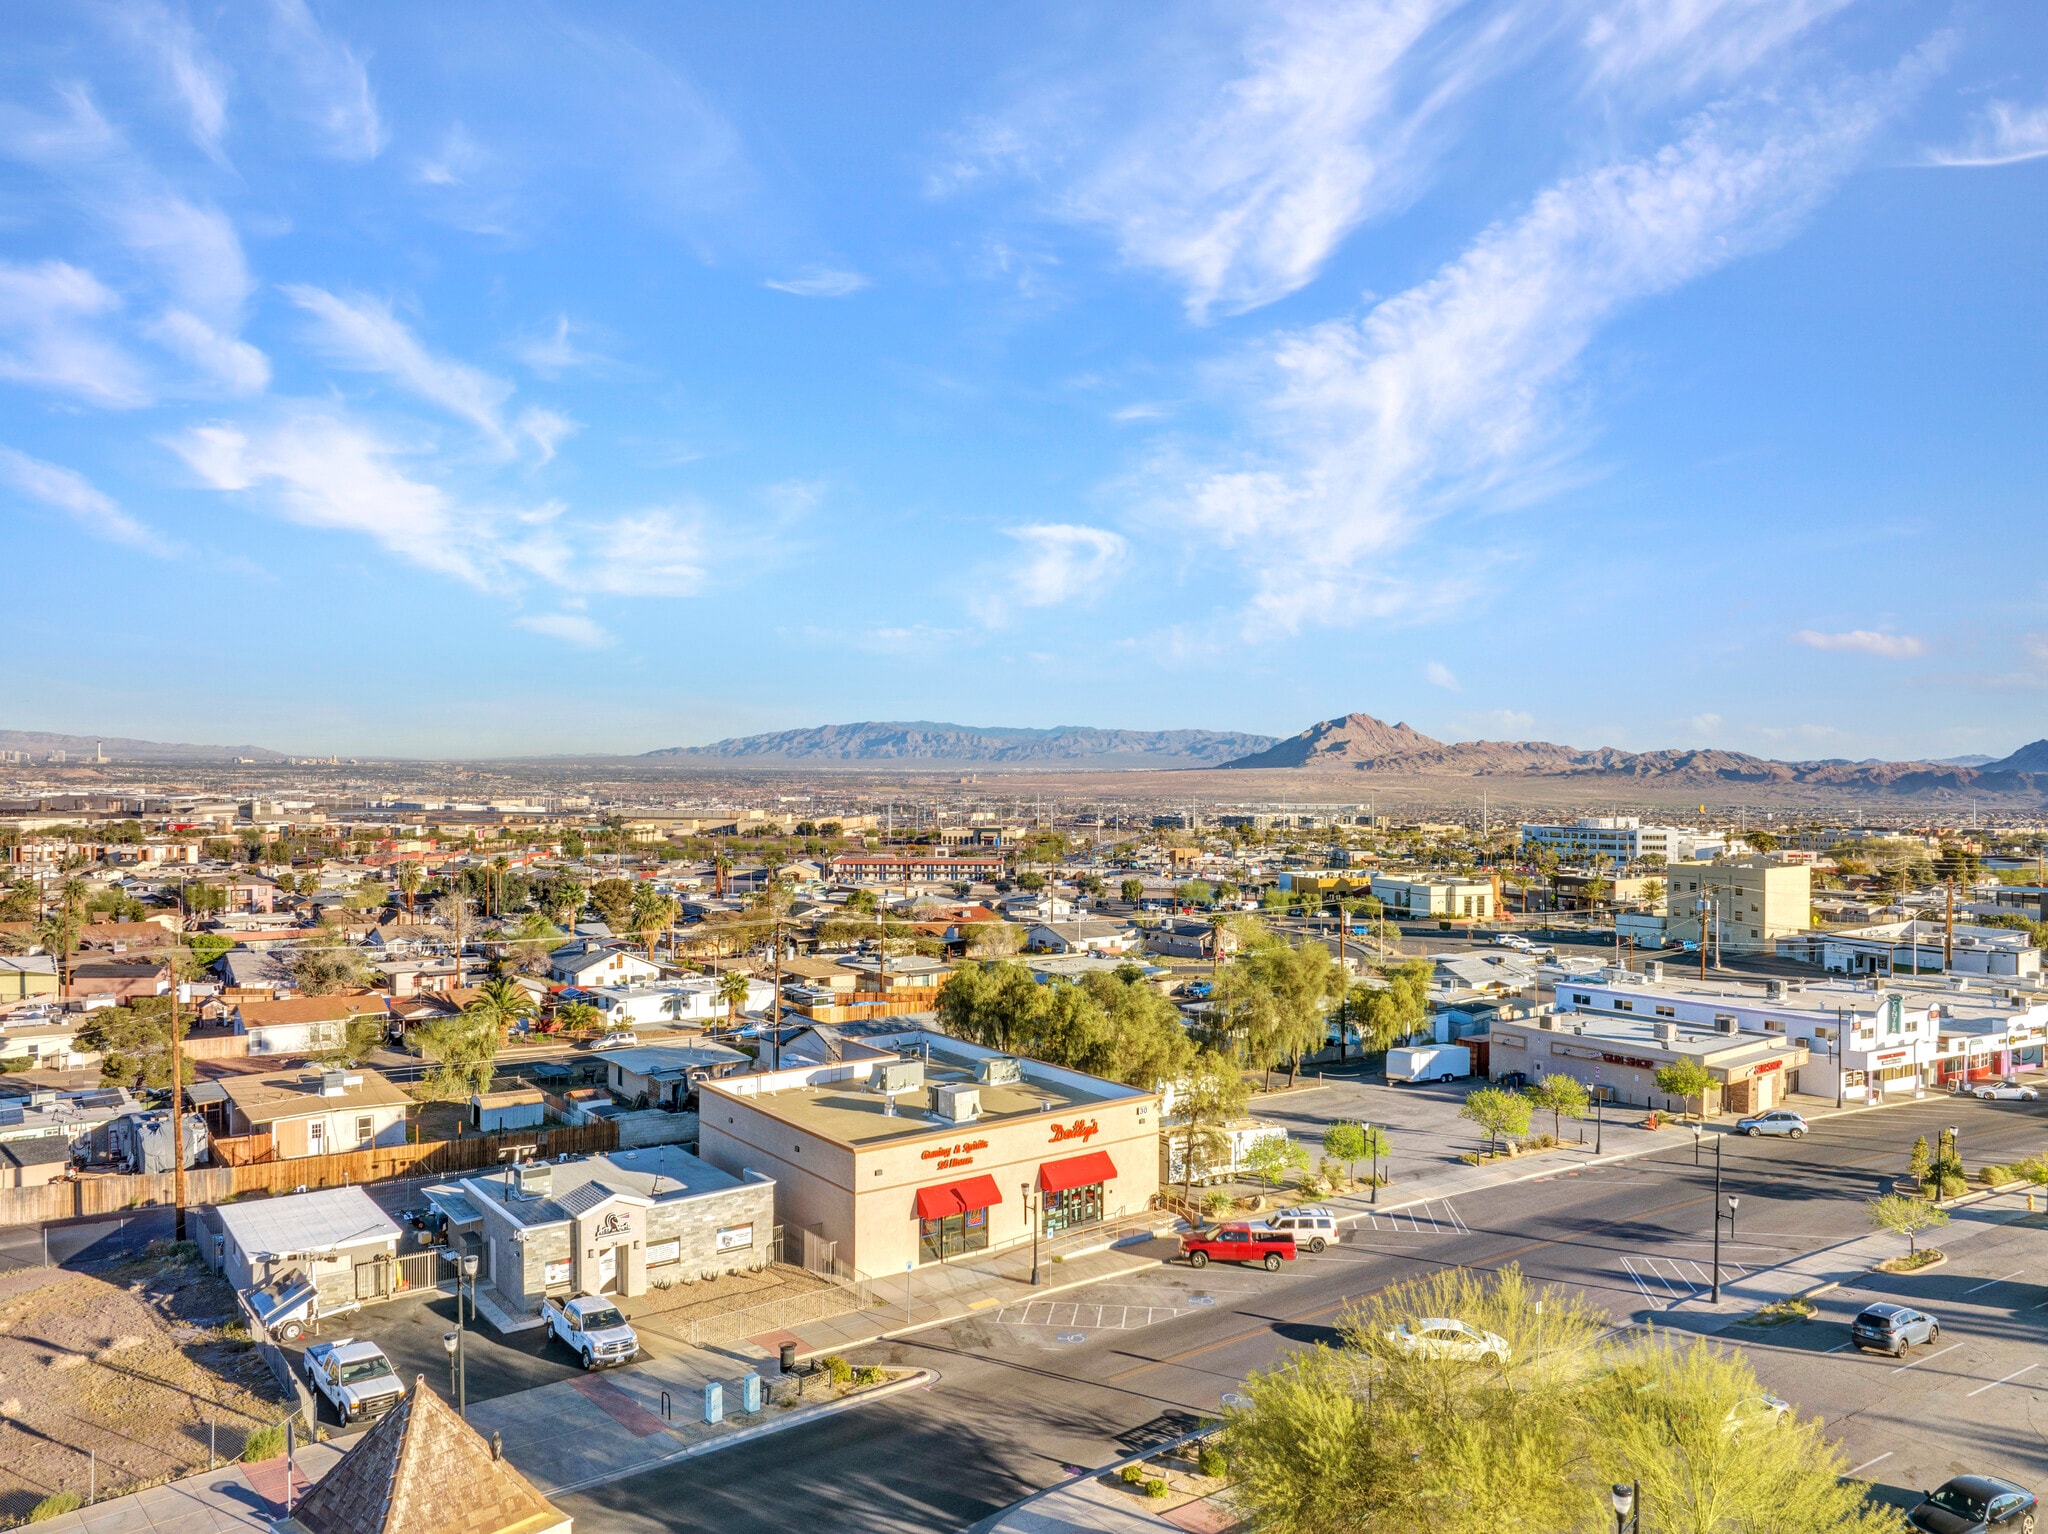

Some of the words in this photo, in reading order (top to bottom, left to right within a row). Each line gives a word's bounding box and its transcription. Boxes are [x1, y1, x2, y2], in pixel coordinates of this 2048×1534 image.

[1602, 1053, 1624, 1064] GUN
[1625, 1056, 1654, 1069] SHOP
[1048, 1118, 1099, 1143] Dotty's
[920, 1147, 952, 1160] Gaming
